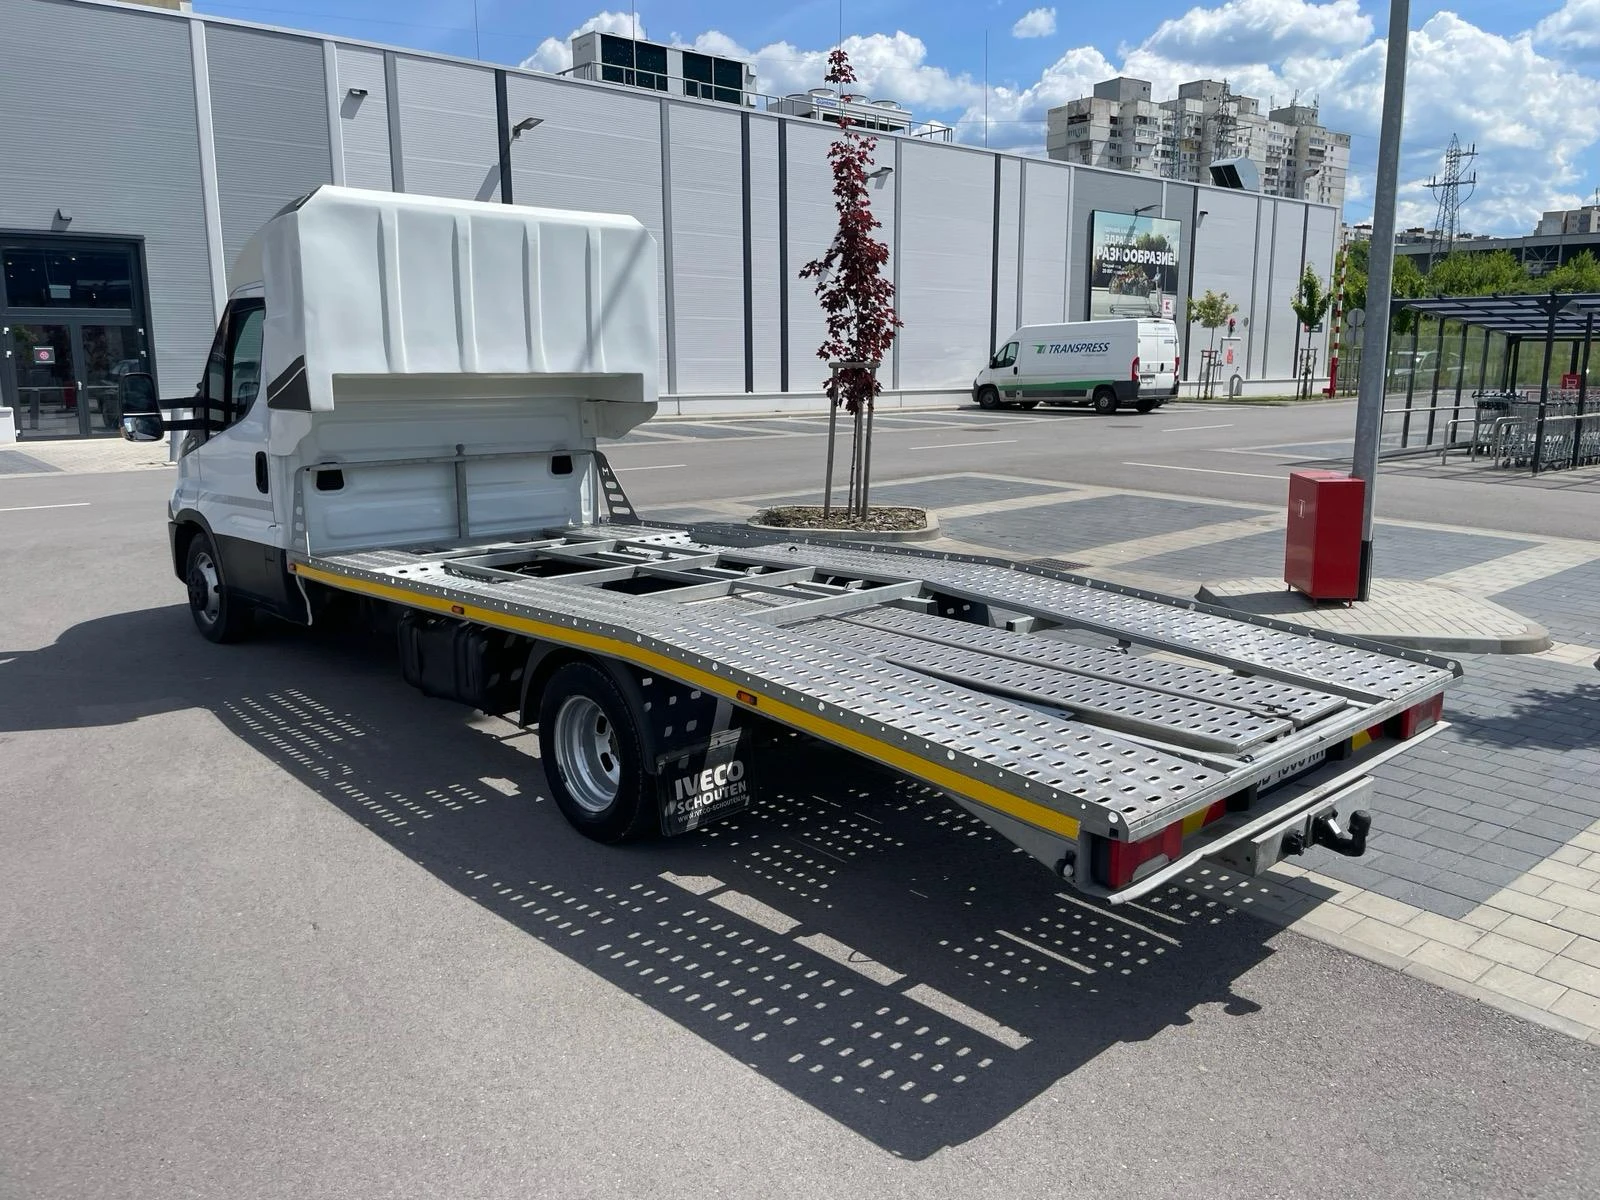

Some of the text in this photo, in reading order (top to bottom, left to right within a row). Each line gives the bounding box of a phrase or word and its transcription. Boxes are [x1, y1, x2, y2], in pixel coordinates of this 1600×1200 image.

[1096, 246, 1176, 266] РАЗНООБРАЗИЕ!
[1049, 342, 1111, 354] TRANSPRESS
[675, 760, 744, 801] IVECO
[677, 780, 747, 815] SCHOUTEN
